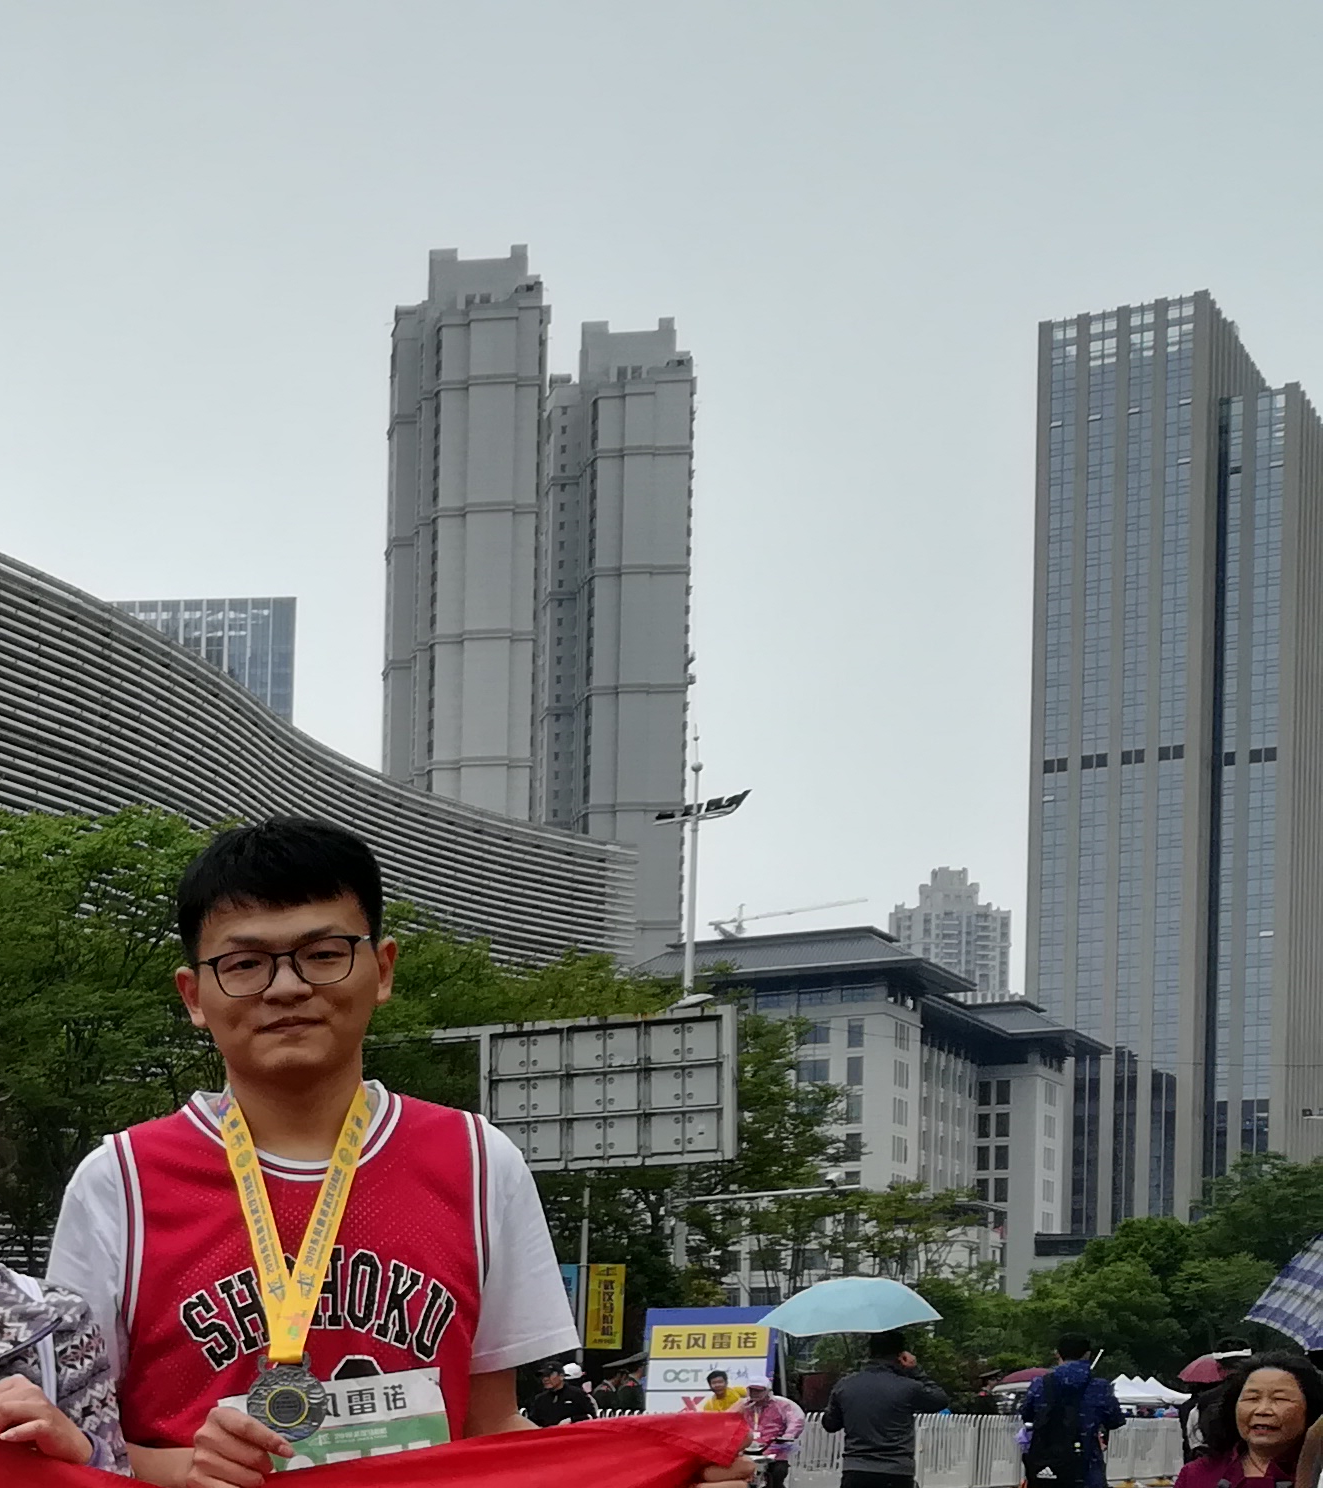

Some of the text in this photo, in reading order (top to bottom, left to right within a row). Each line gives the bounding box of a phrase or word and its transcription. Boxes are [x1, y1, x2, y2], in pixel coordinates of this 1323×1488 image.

[178, 1244, 458, 1373] SHHOKU
[662, 1331, 758, 1350] 东风雷诺
[663, 1369, 704, 1383] OCT
